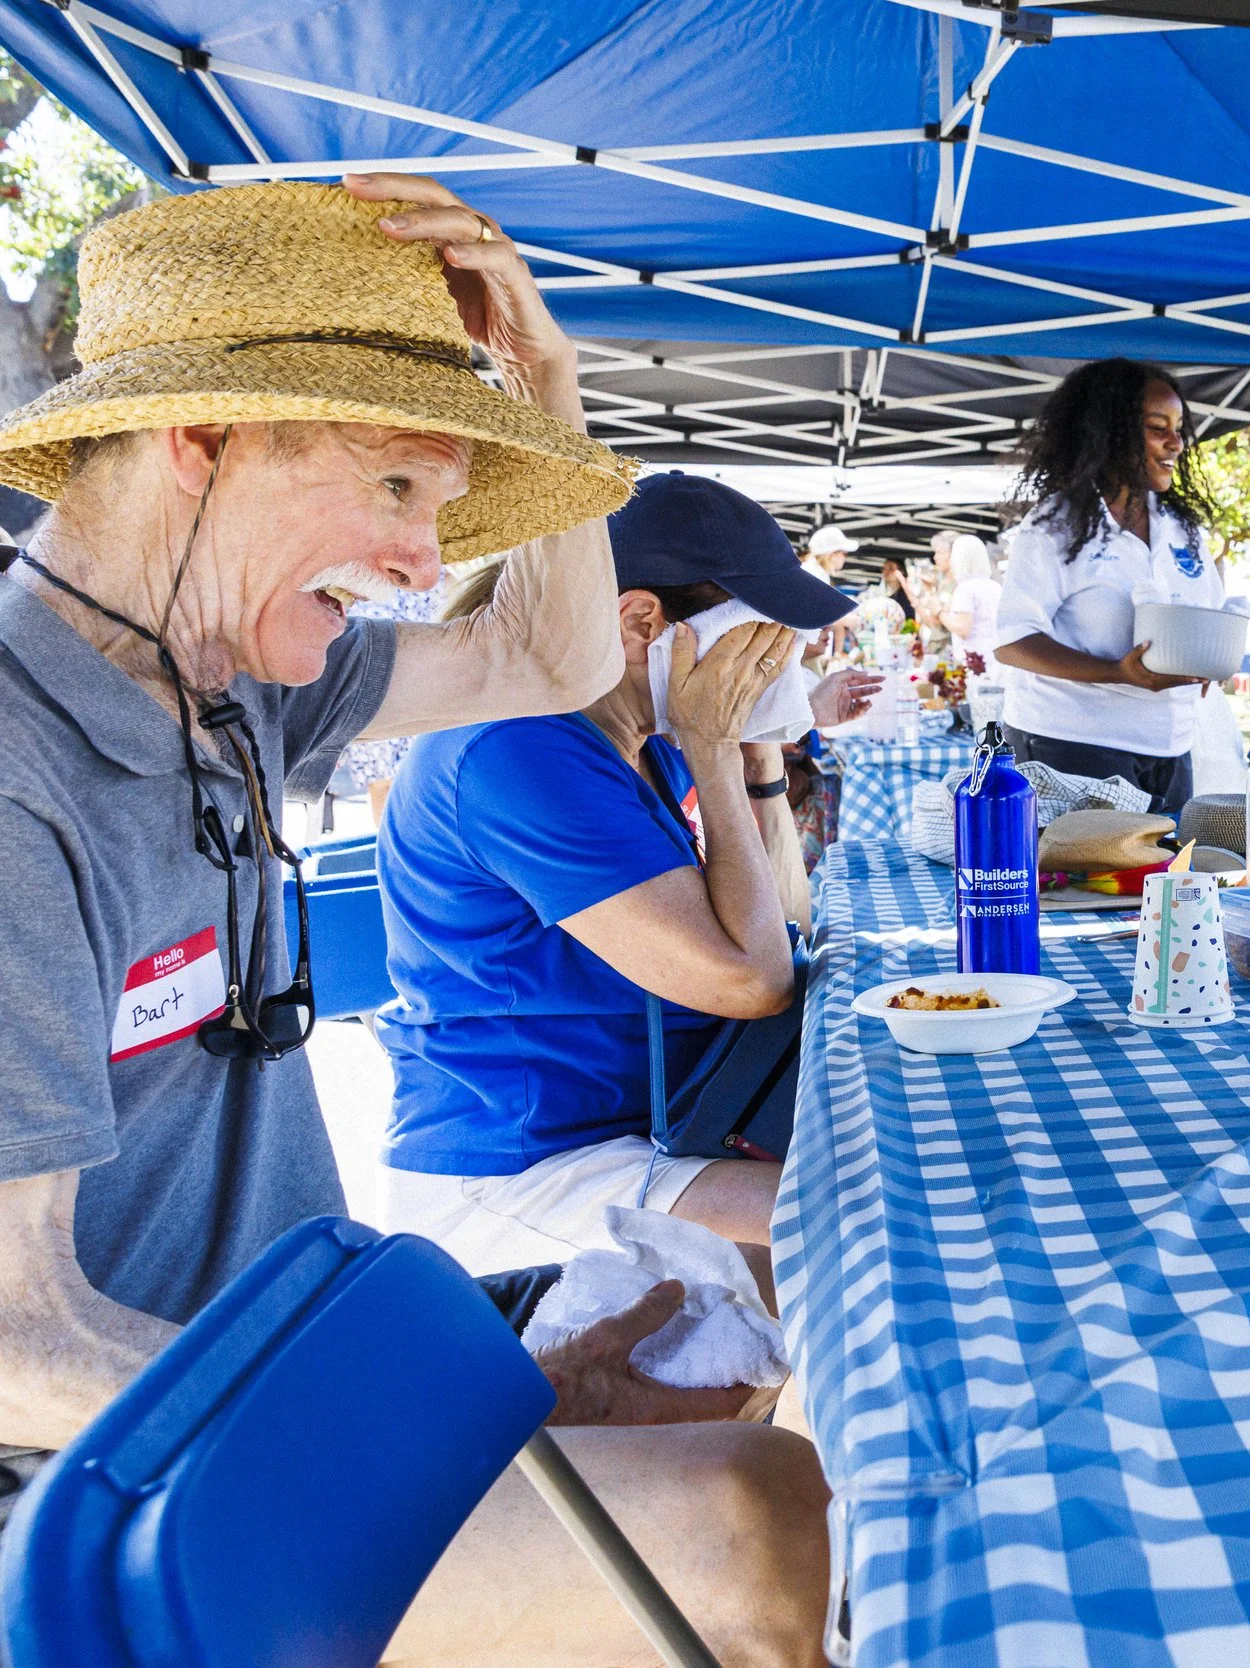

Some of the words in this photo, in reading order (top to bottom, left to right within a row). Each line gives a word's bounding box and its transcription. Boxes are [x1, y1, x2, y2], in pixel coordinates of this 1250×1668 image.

[974, 868, 1029, 881] Builders
[974, 881, 1029, 891] FirstSource
[977, 902, 1030, 914] ANDERSEN
[153, 948, 184, 971] Hello
[166, 962, 181, 973] name
[132, 986, 184, 1028] Bart
